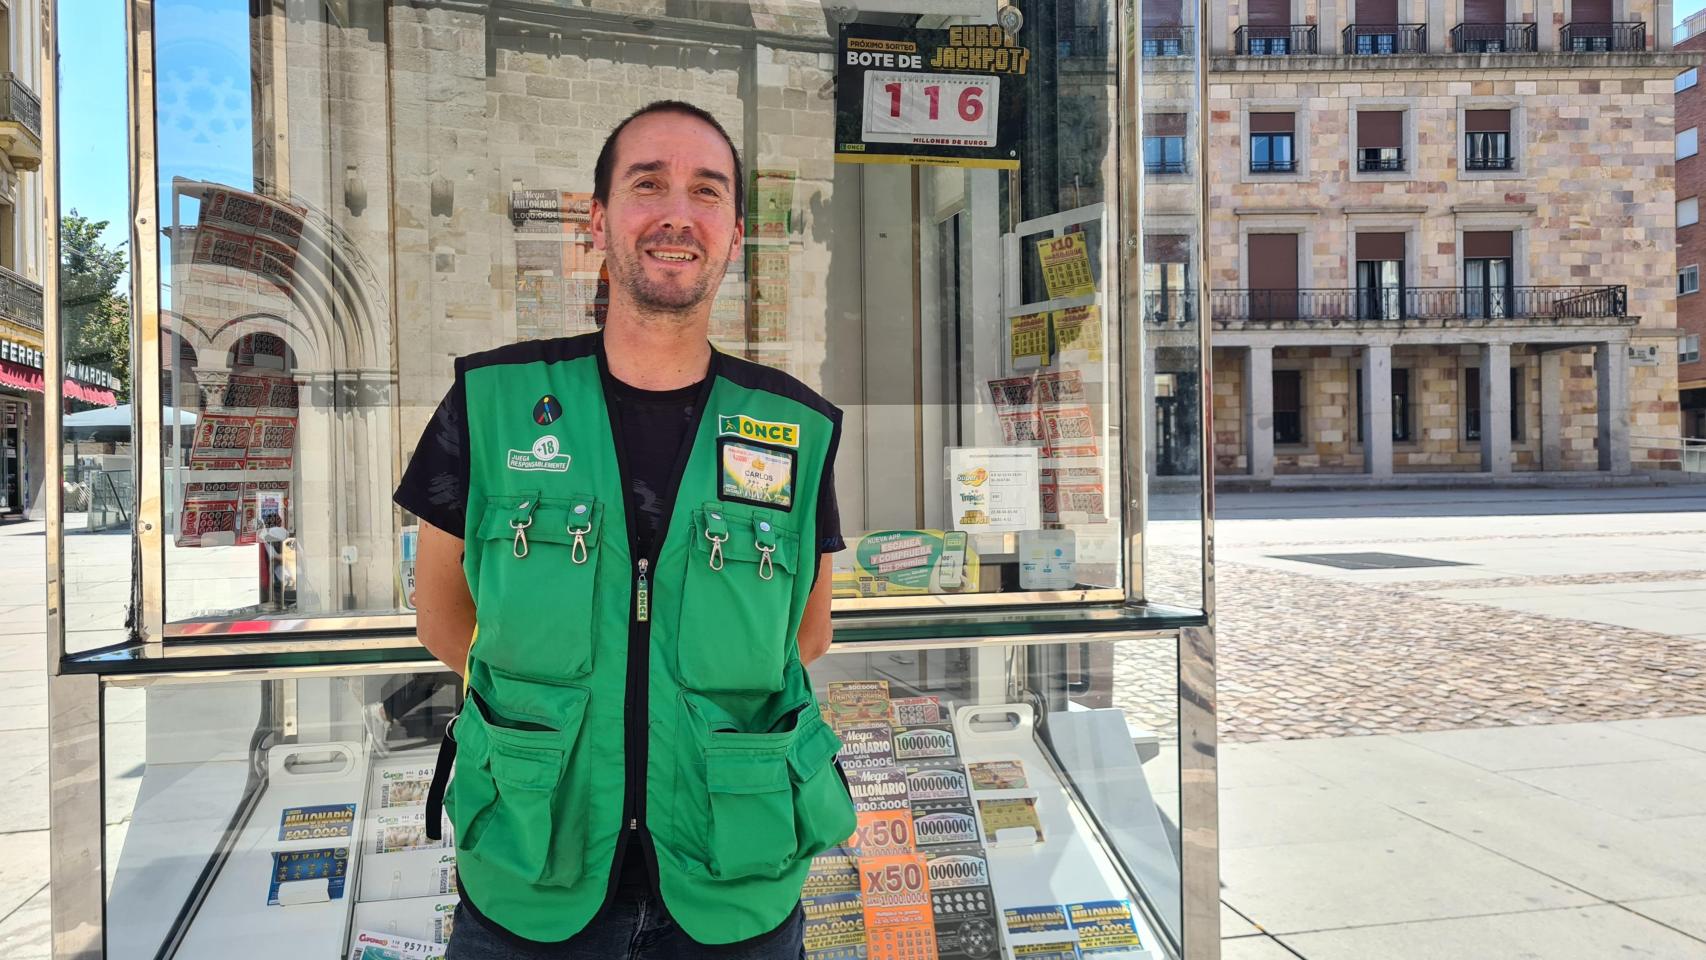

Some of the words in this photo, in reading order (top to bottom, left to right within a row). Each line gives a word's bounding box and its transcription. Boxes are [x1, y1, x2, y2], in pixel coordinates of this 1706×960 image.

[950, 25, 1002, 47] EURO
[850, 40, 884, 50] PRÓXIMO
[885, 43, 914, 52] SORTEO
[846, 51, 894, 67] BOTE
[898, 54, 922, 69] DE
[913, 137, 950, 145] MILLONES
[513, 200, 558, 209] MILLONARIO
[0, 339, 44, 369] FERRE
[743, 420, 793, 442] ONCE
[536, 441, 555, 456] +18
[511, 454, 531, 462] JUEGA
[510, 460, 567, 470] RESPONSABLEMENTE
[744, 470, 774, 482] CARLOS
[639, 591, 647, 619] ONCE
[846, 730, 874, 742] Mega
[861, 771, 889, 783] Mega
[285, 827, 348, 840] 500.000€
